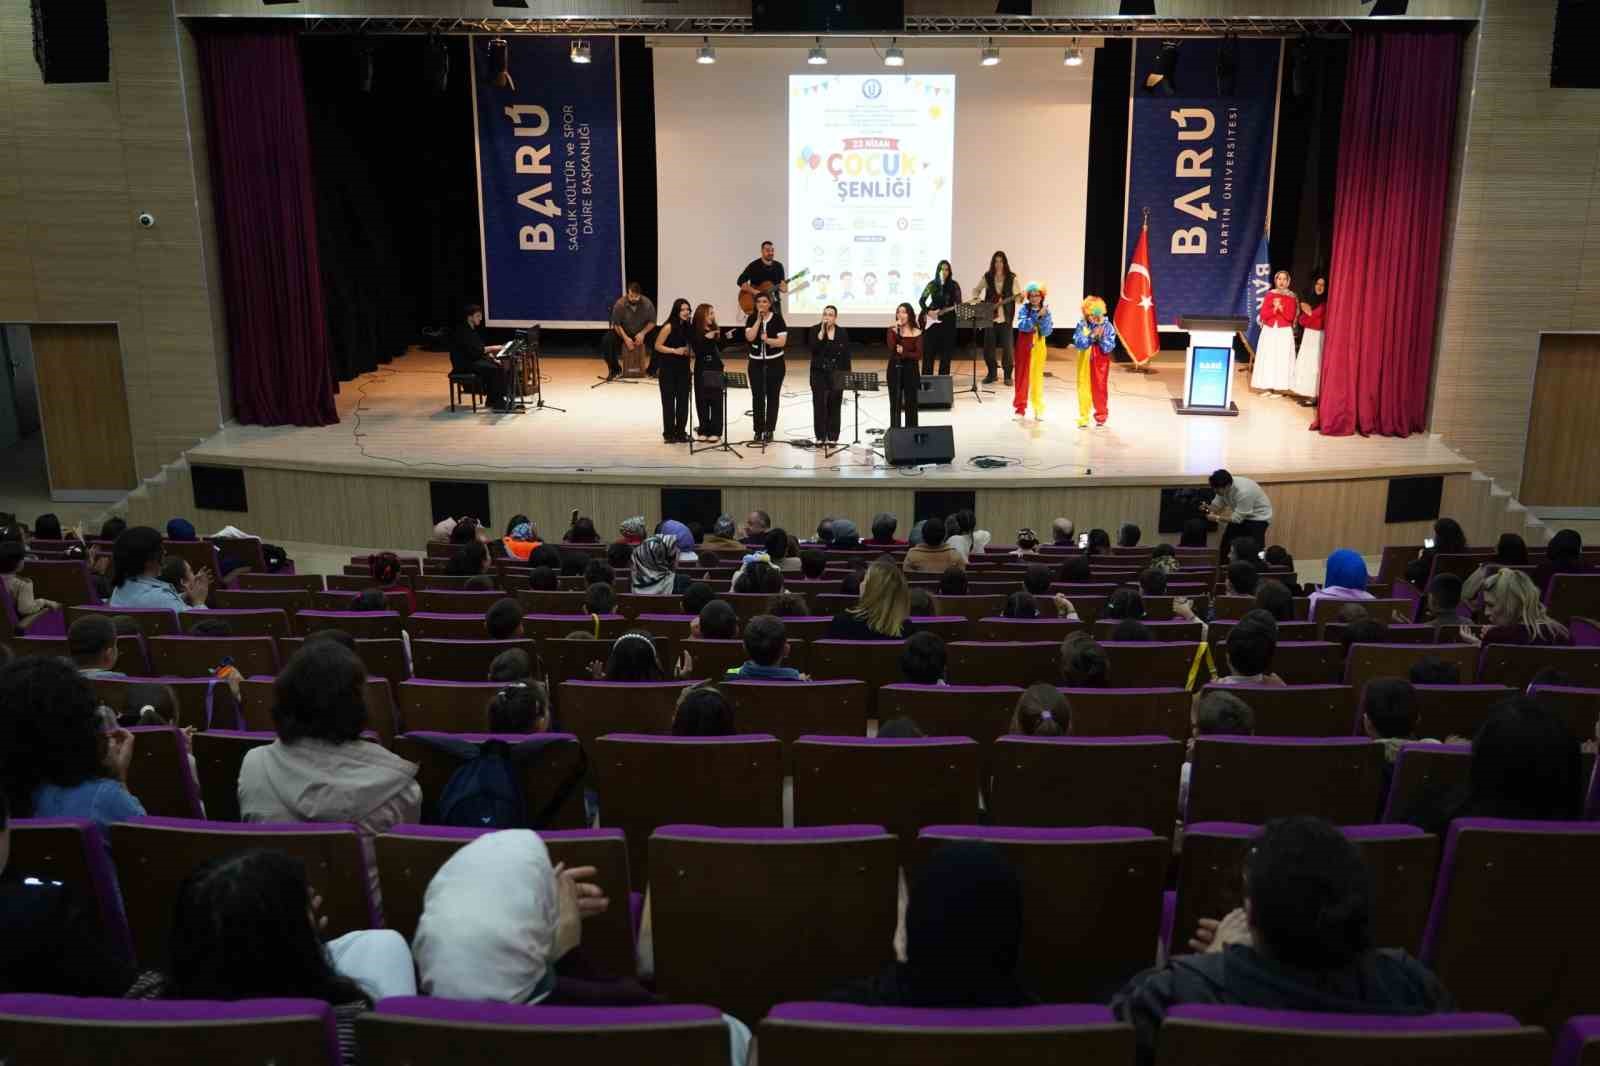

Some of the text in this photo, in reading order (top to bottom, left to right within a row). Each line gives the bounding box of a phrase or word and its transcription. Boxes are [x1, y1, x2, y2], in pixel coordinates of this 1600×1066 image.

[562, 104, 579, 250] SAĞLIK KÜLTÜR ve SPOR
[826, 152, 918, 182] ÇOCUK
[837, 177, 912, 203] ŞENLİĞİ
